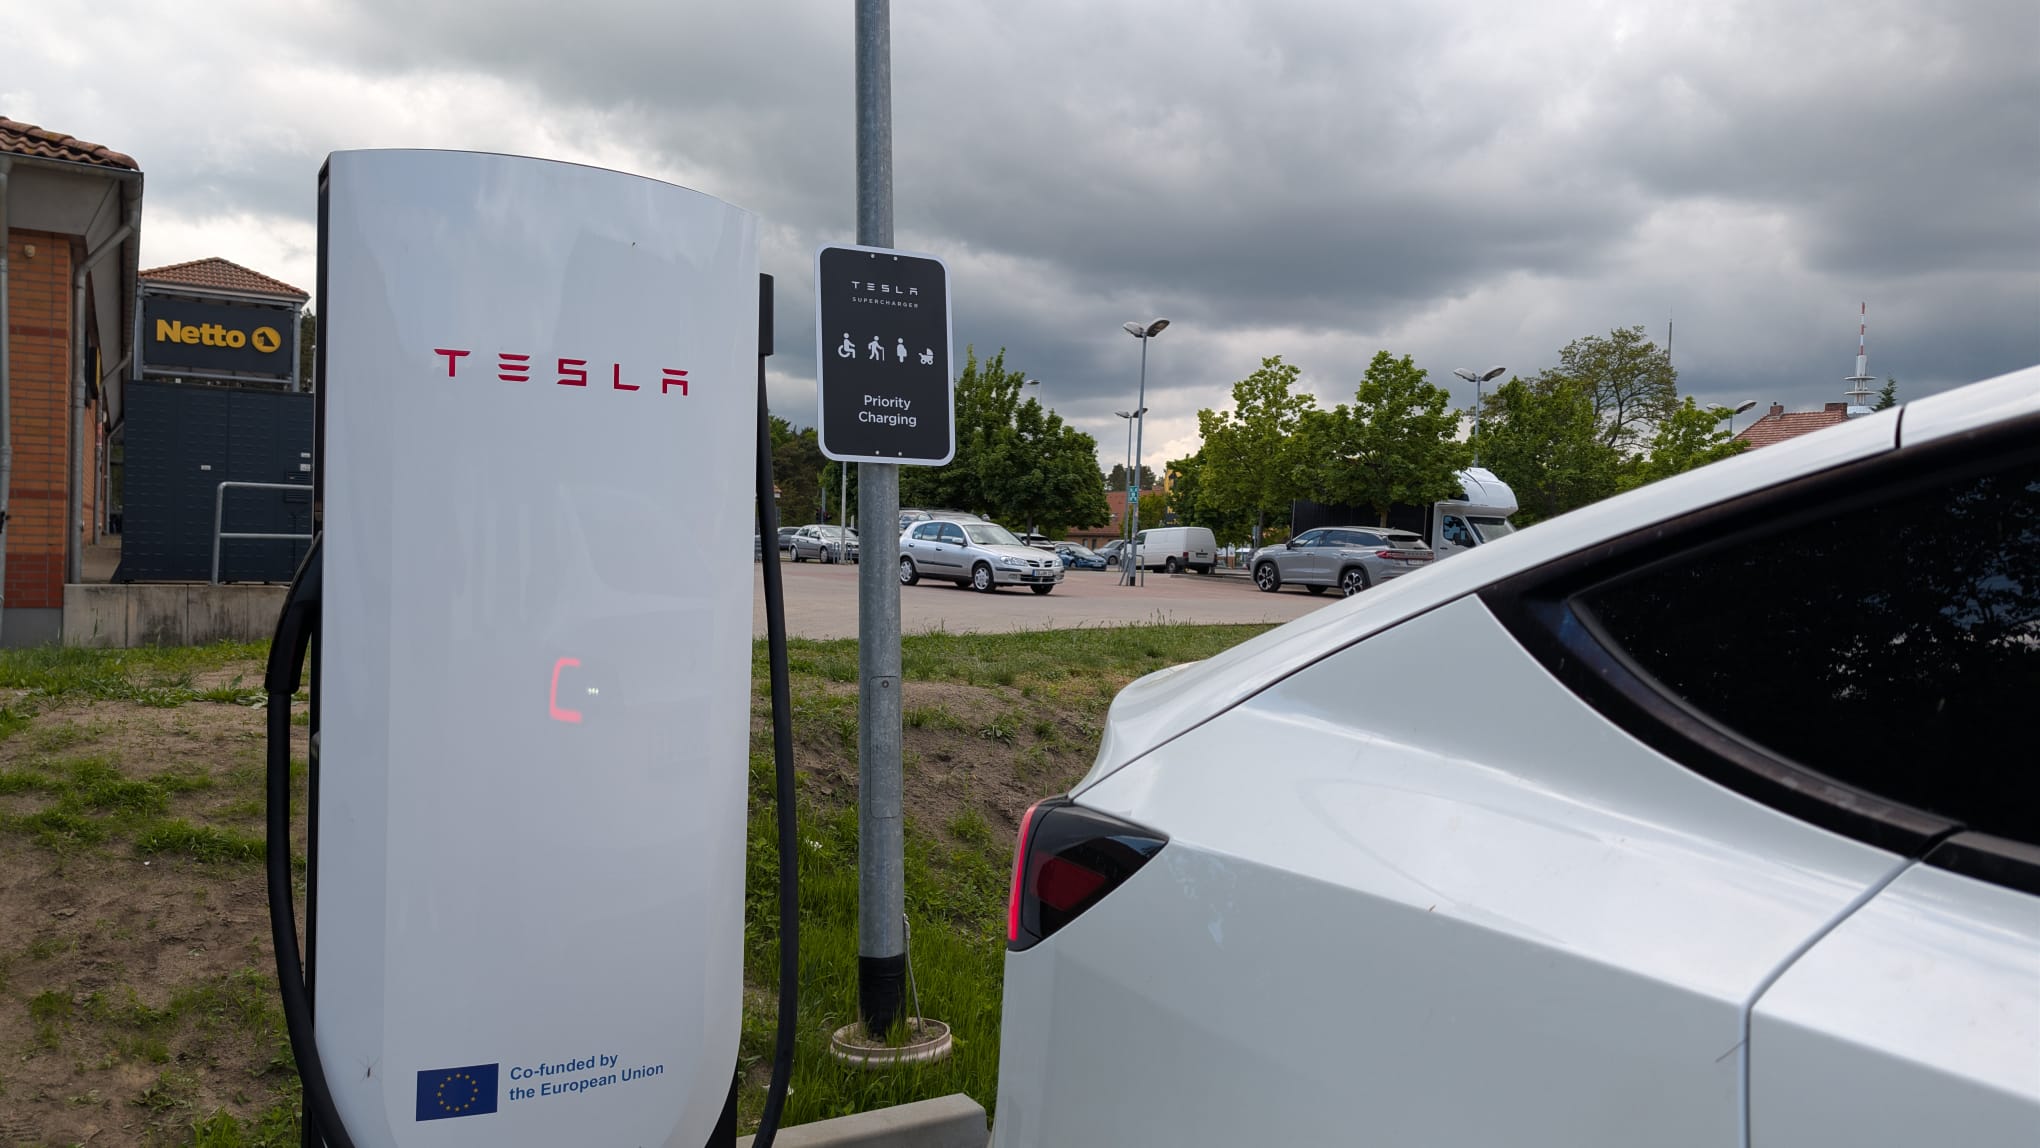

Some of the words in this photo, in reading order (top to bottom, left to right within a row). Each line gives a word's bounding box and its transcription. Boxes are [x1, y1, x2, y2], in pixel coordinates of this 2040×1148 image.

[851, 281, 918, 296] TESLA
[852, 297, 918, 308] SUPERCHARGER
[156, 319, 246, 348] Netto
[433, 348, 689, 396] TESLA
[863, 394, 911, 410] Priority
[858, 411, 917, 428] Charging
[510, 1055, 595, 1080] Co-funded
[600, 1053, 618, 1068] by
[509, 1087, 536, 1101] the
[541, 1074, 617, 1096] European
[621, 1063, 664, 1082] Union
